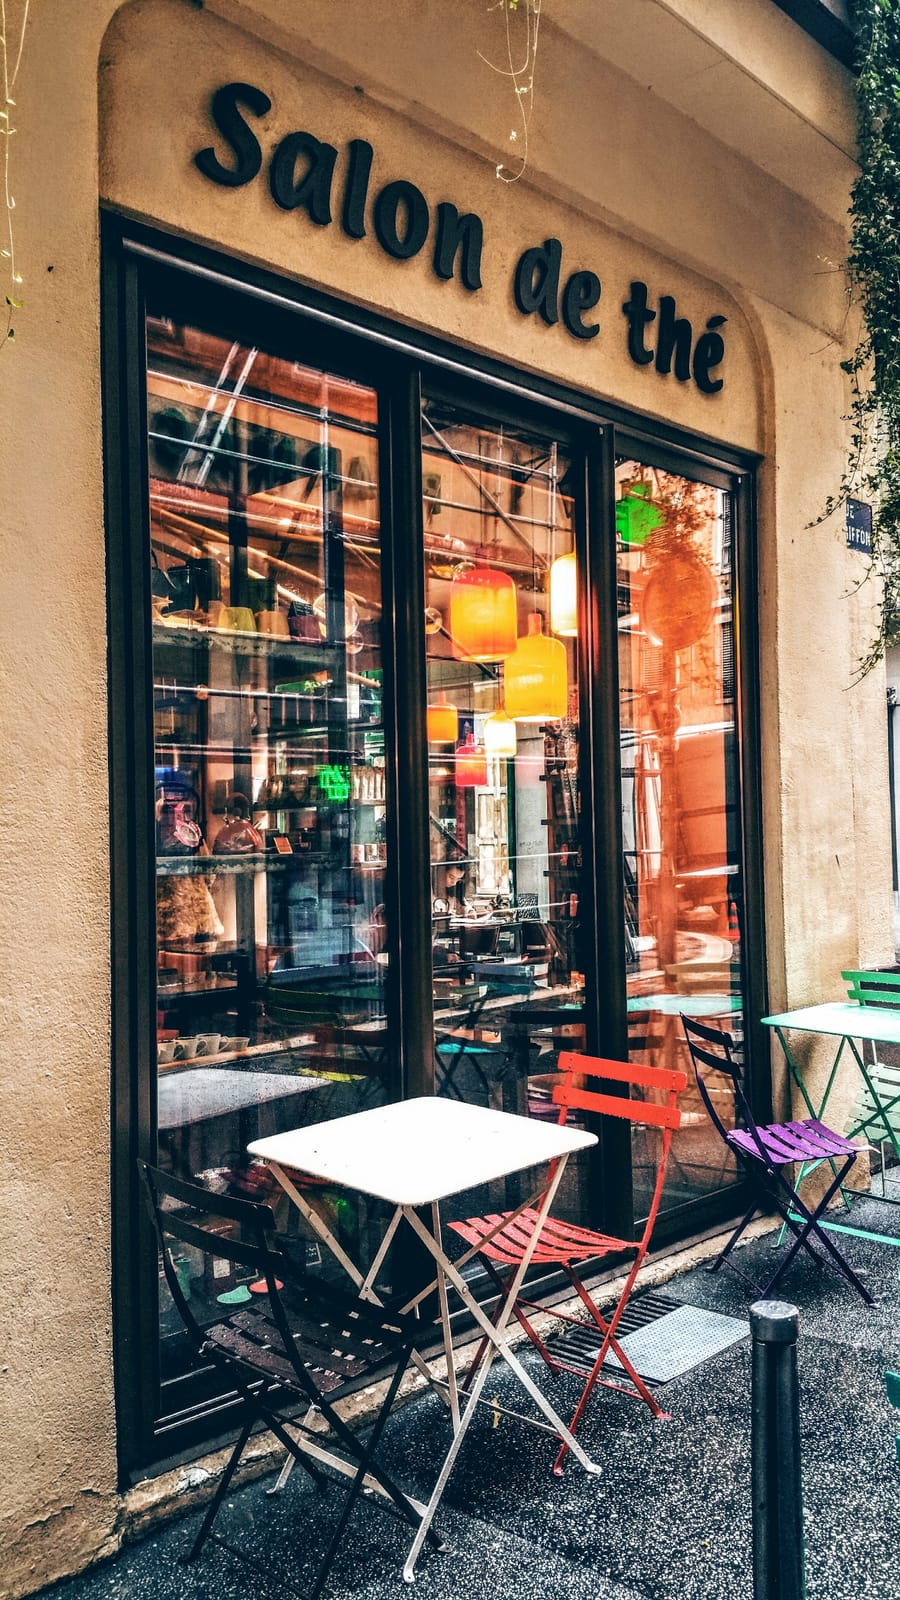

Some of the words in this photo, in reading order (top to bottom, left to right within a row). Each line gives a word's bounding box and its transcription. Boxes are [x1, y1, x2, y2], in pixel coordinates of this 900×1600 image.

[195, 82, 483, 290] Salon
[514, 238, 601, 339] de
[622, 281, 728, 394] thé
[846, 525, 871, 547] IFFON
